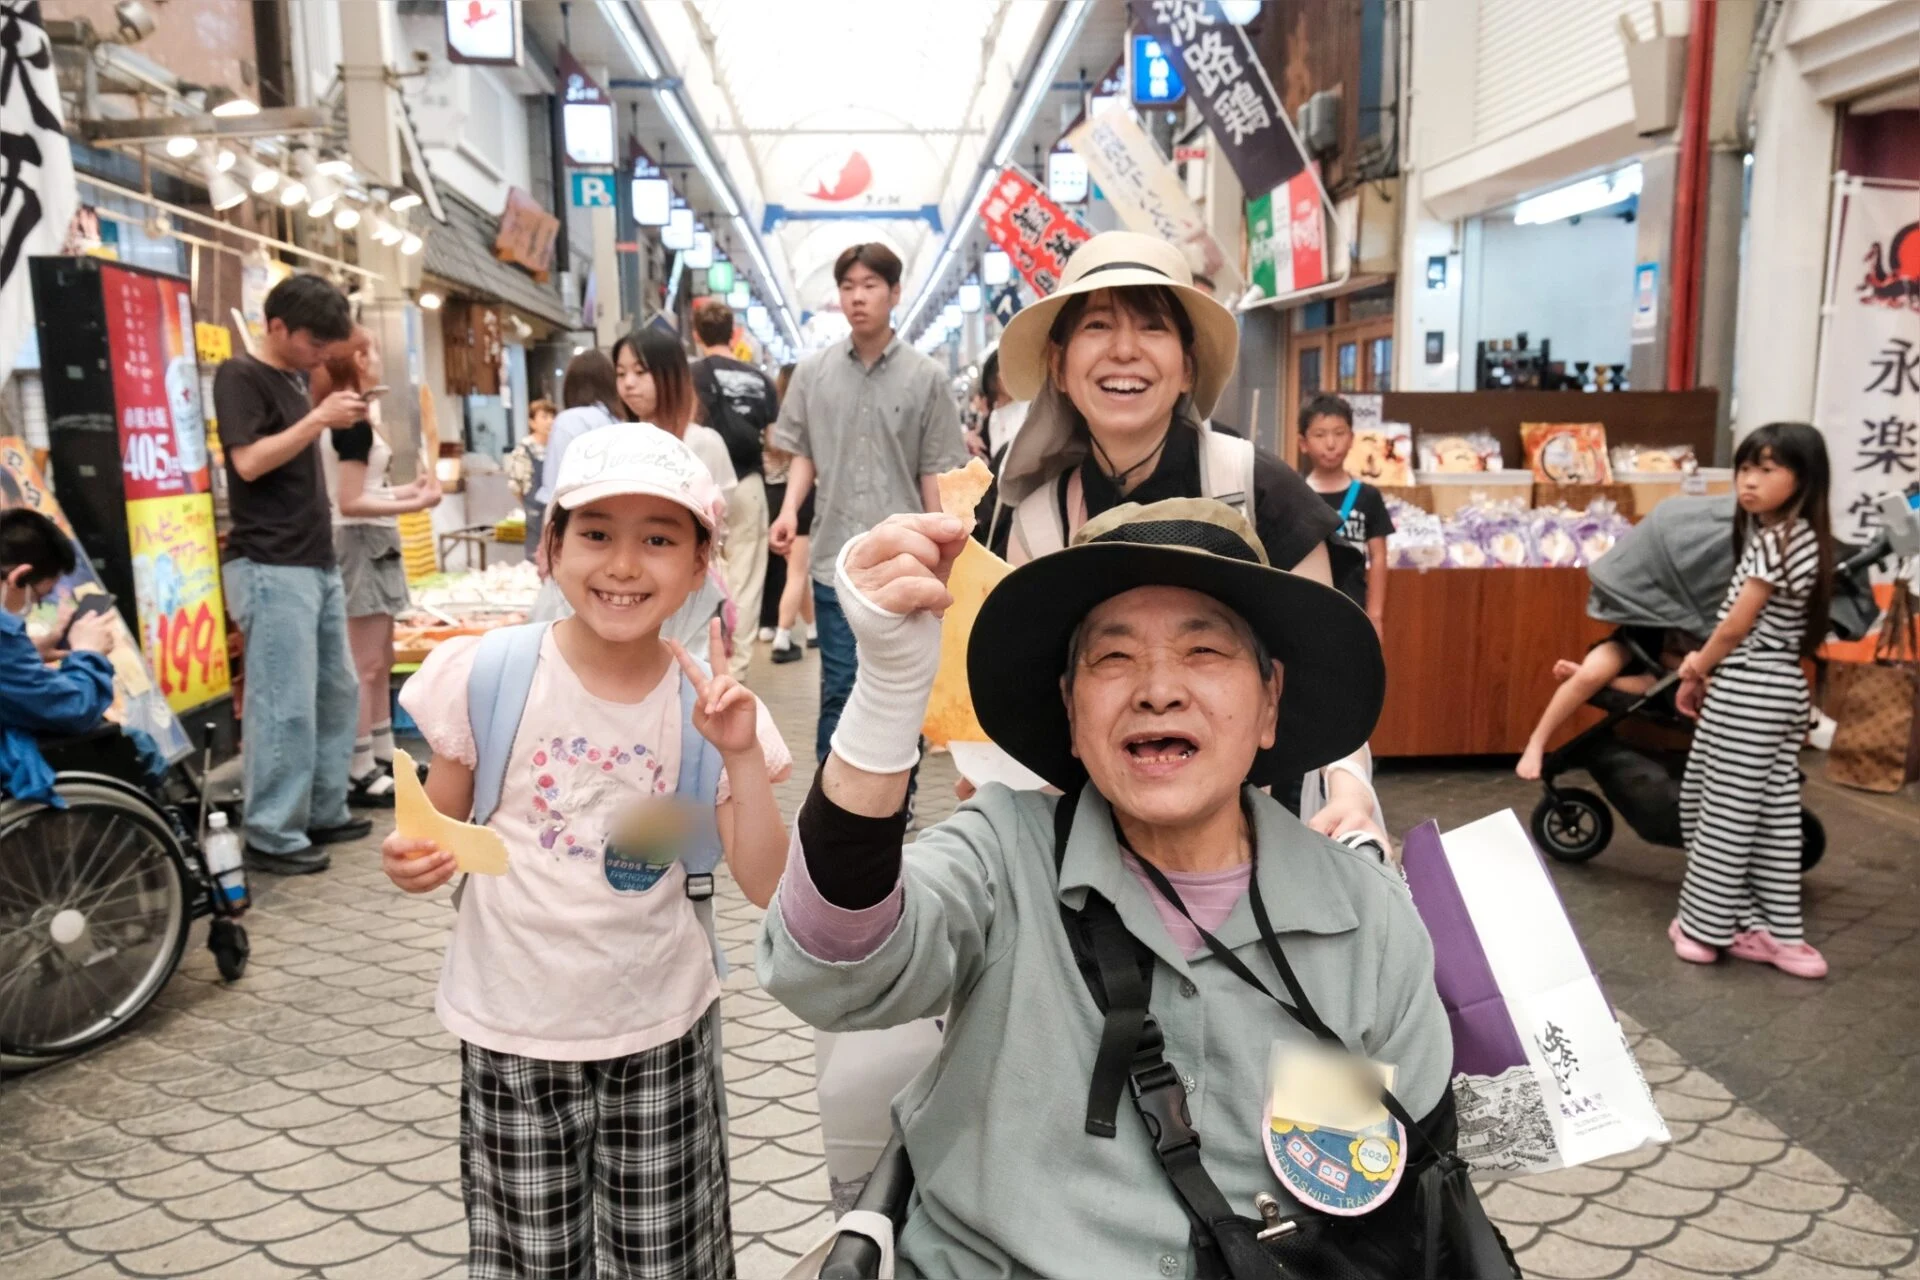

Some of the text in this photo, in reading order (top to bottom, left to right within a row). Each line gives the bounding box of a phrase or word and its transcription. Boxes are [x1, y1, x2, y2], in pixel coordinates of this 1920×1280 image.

[132, 511, 183, 552] ハッピー
[1270, 1134, 1331, 1202] FRIENDSHIP
[1336, 1189, 1380, 1209] TRAIN
